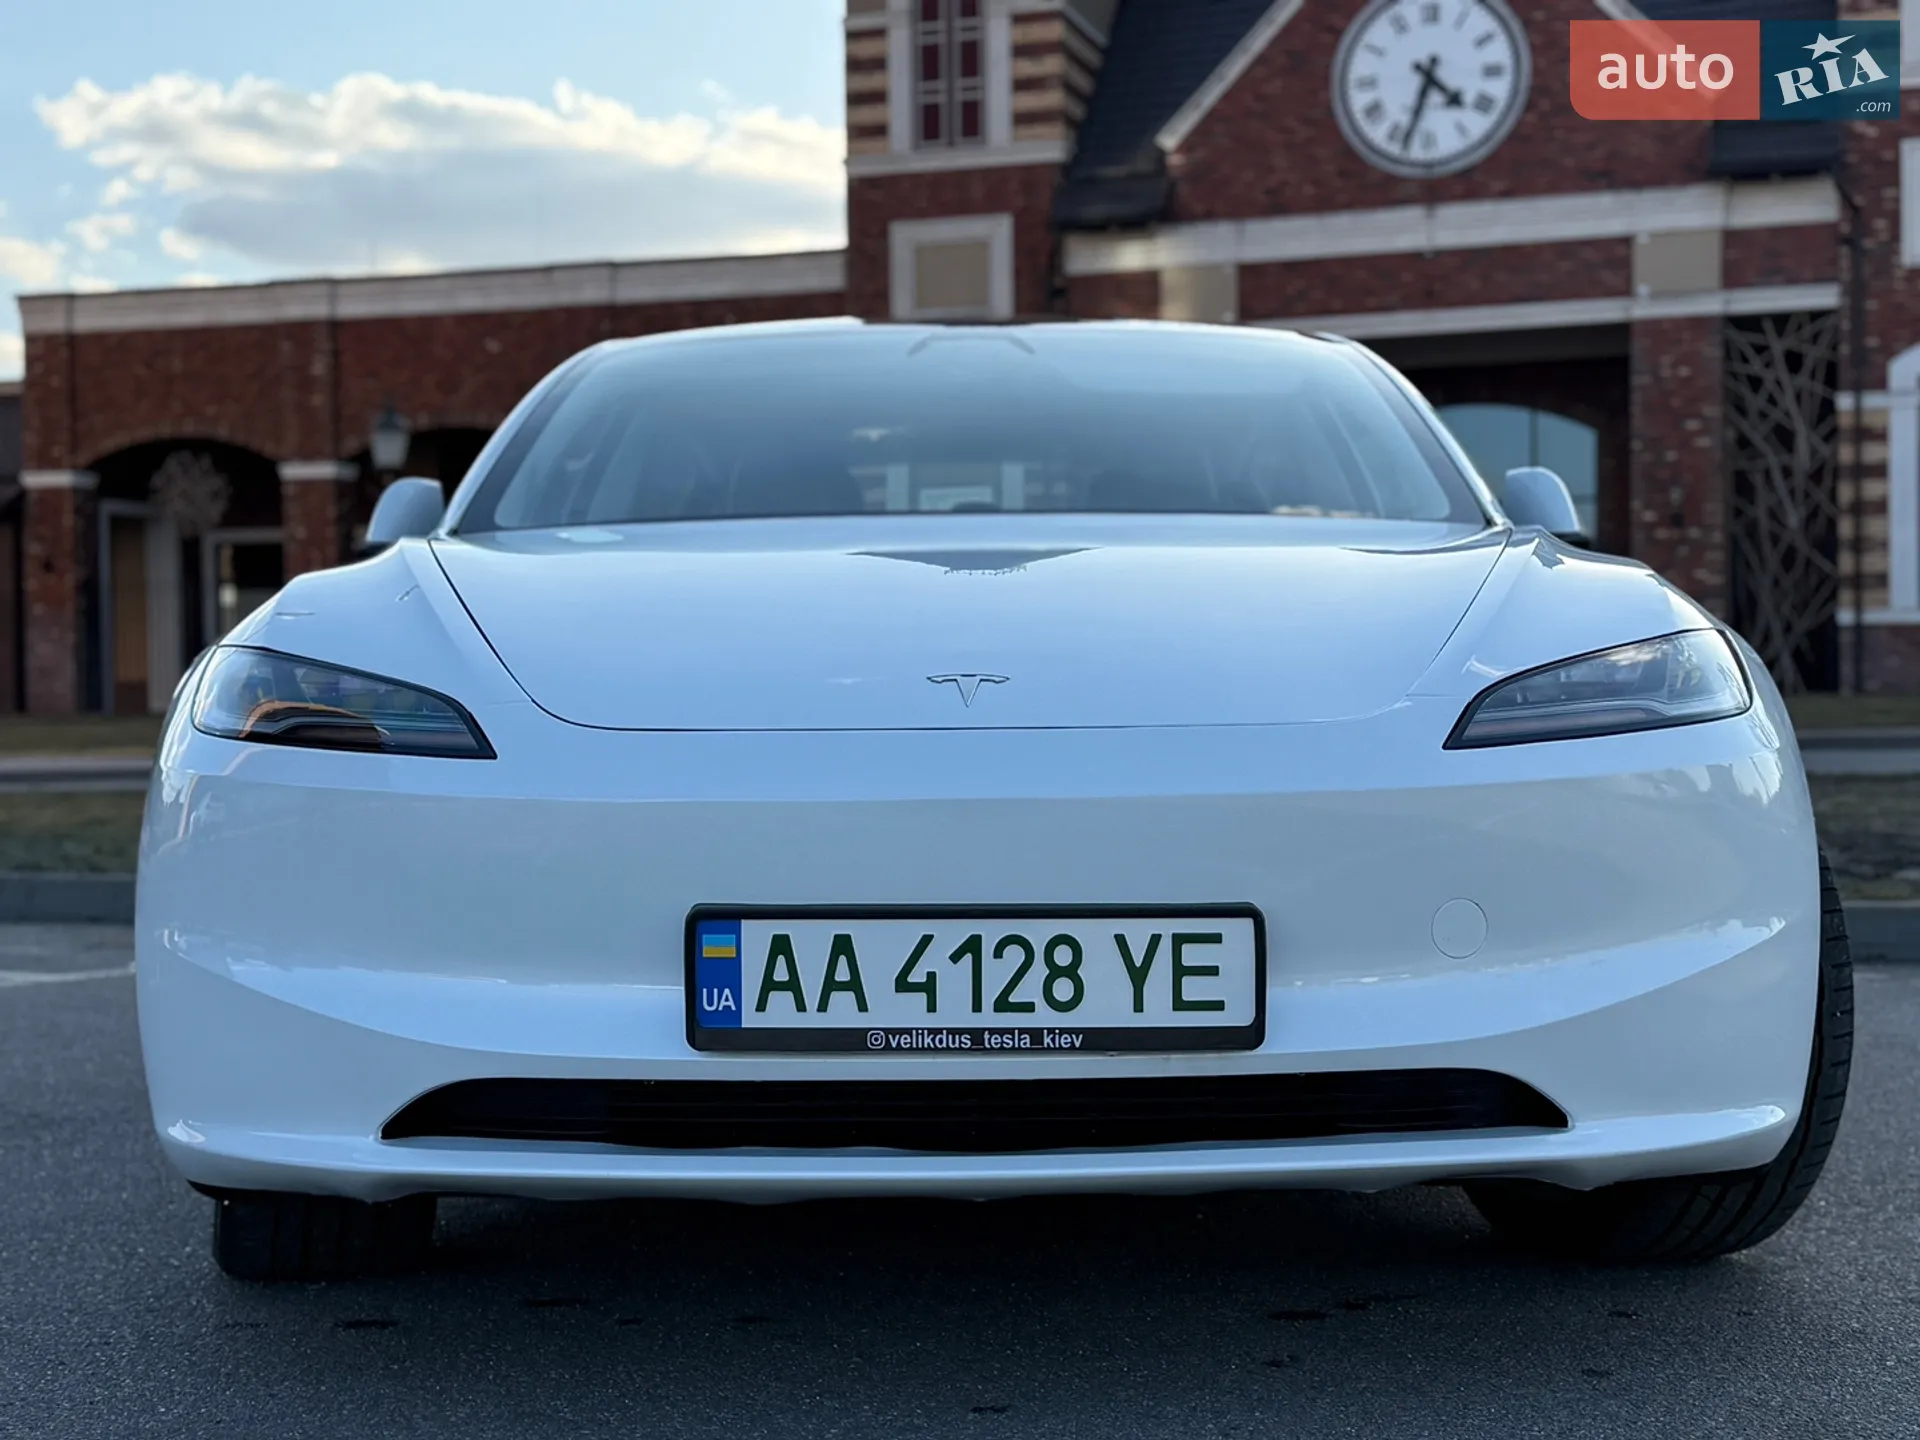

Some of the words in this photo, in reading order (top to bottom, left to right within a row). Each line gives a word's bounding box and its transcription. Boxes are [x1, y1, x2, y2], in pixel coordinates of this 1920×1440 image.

[754, 933, 869, 1013] AA
[894, 933, 1085, 1014] 4128
[1113, 932, 1226, 1013] YE
[702, 988, 737, 1012] UA
[888, 1029, 1083, 1050] velikdus_tesla_kiev
